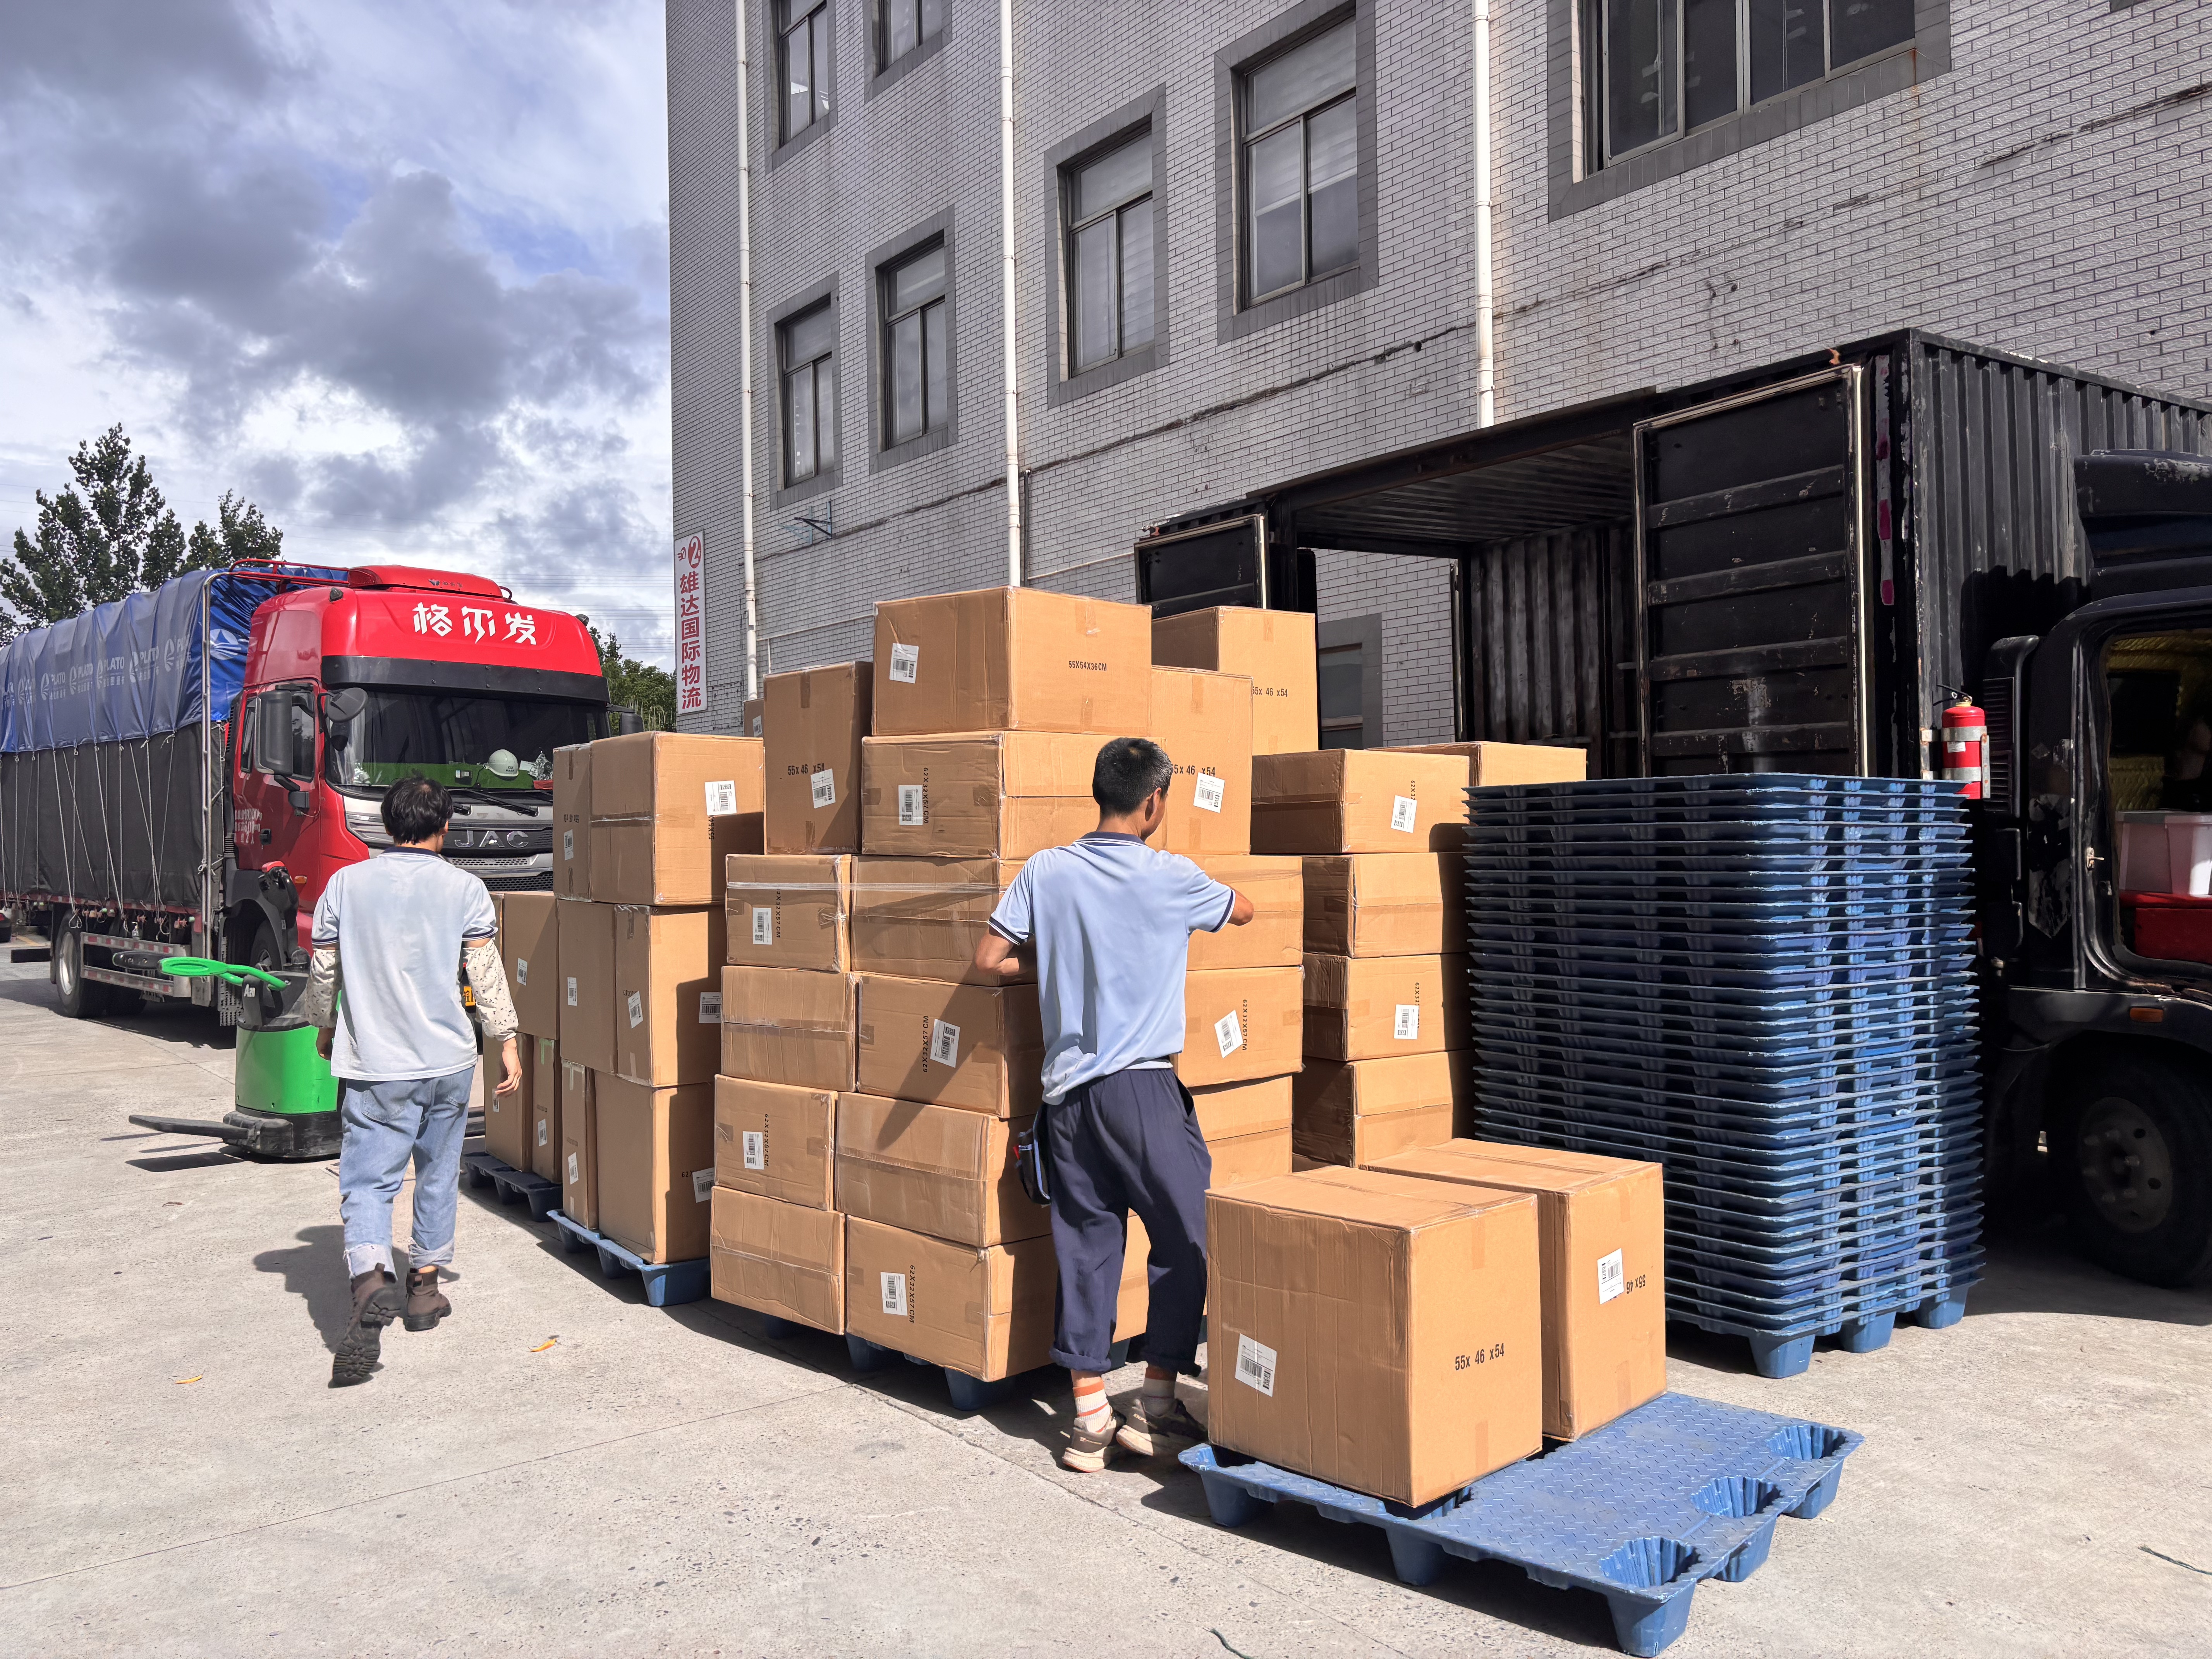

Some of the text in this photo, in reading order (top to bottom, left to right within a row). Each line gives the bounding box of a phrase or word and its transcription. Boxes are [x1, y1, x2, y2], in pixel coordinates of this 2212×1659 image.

[412, 602, 537, 645] 格尔发
[680, 570, 701, 709] 雄达国际物流
[78, 663, 93, 678] PLATO
[1069, 660, 1107, 671] 55X54X36CM
[51, 672, 65, 685] PLATO
[1266, 688, 1273, 696] 46
[1277, 688, 1288, 697] x54
[788, 766, 799, 775] 55x
[801, 764, 808, 774] 46
[1172, 764, 1215, 777] 5x 46 x54
[455, 830, 529, 848] JAC
[1626, 1280, 1633, 1294] 46
[1635, 1274, 1645, 1288] 55x
[1455, 1343, 1504, 1370] 55x 46 x54
